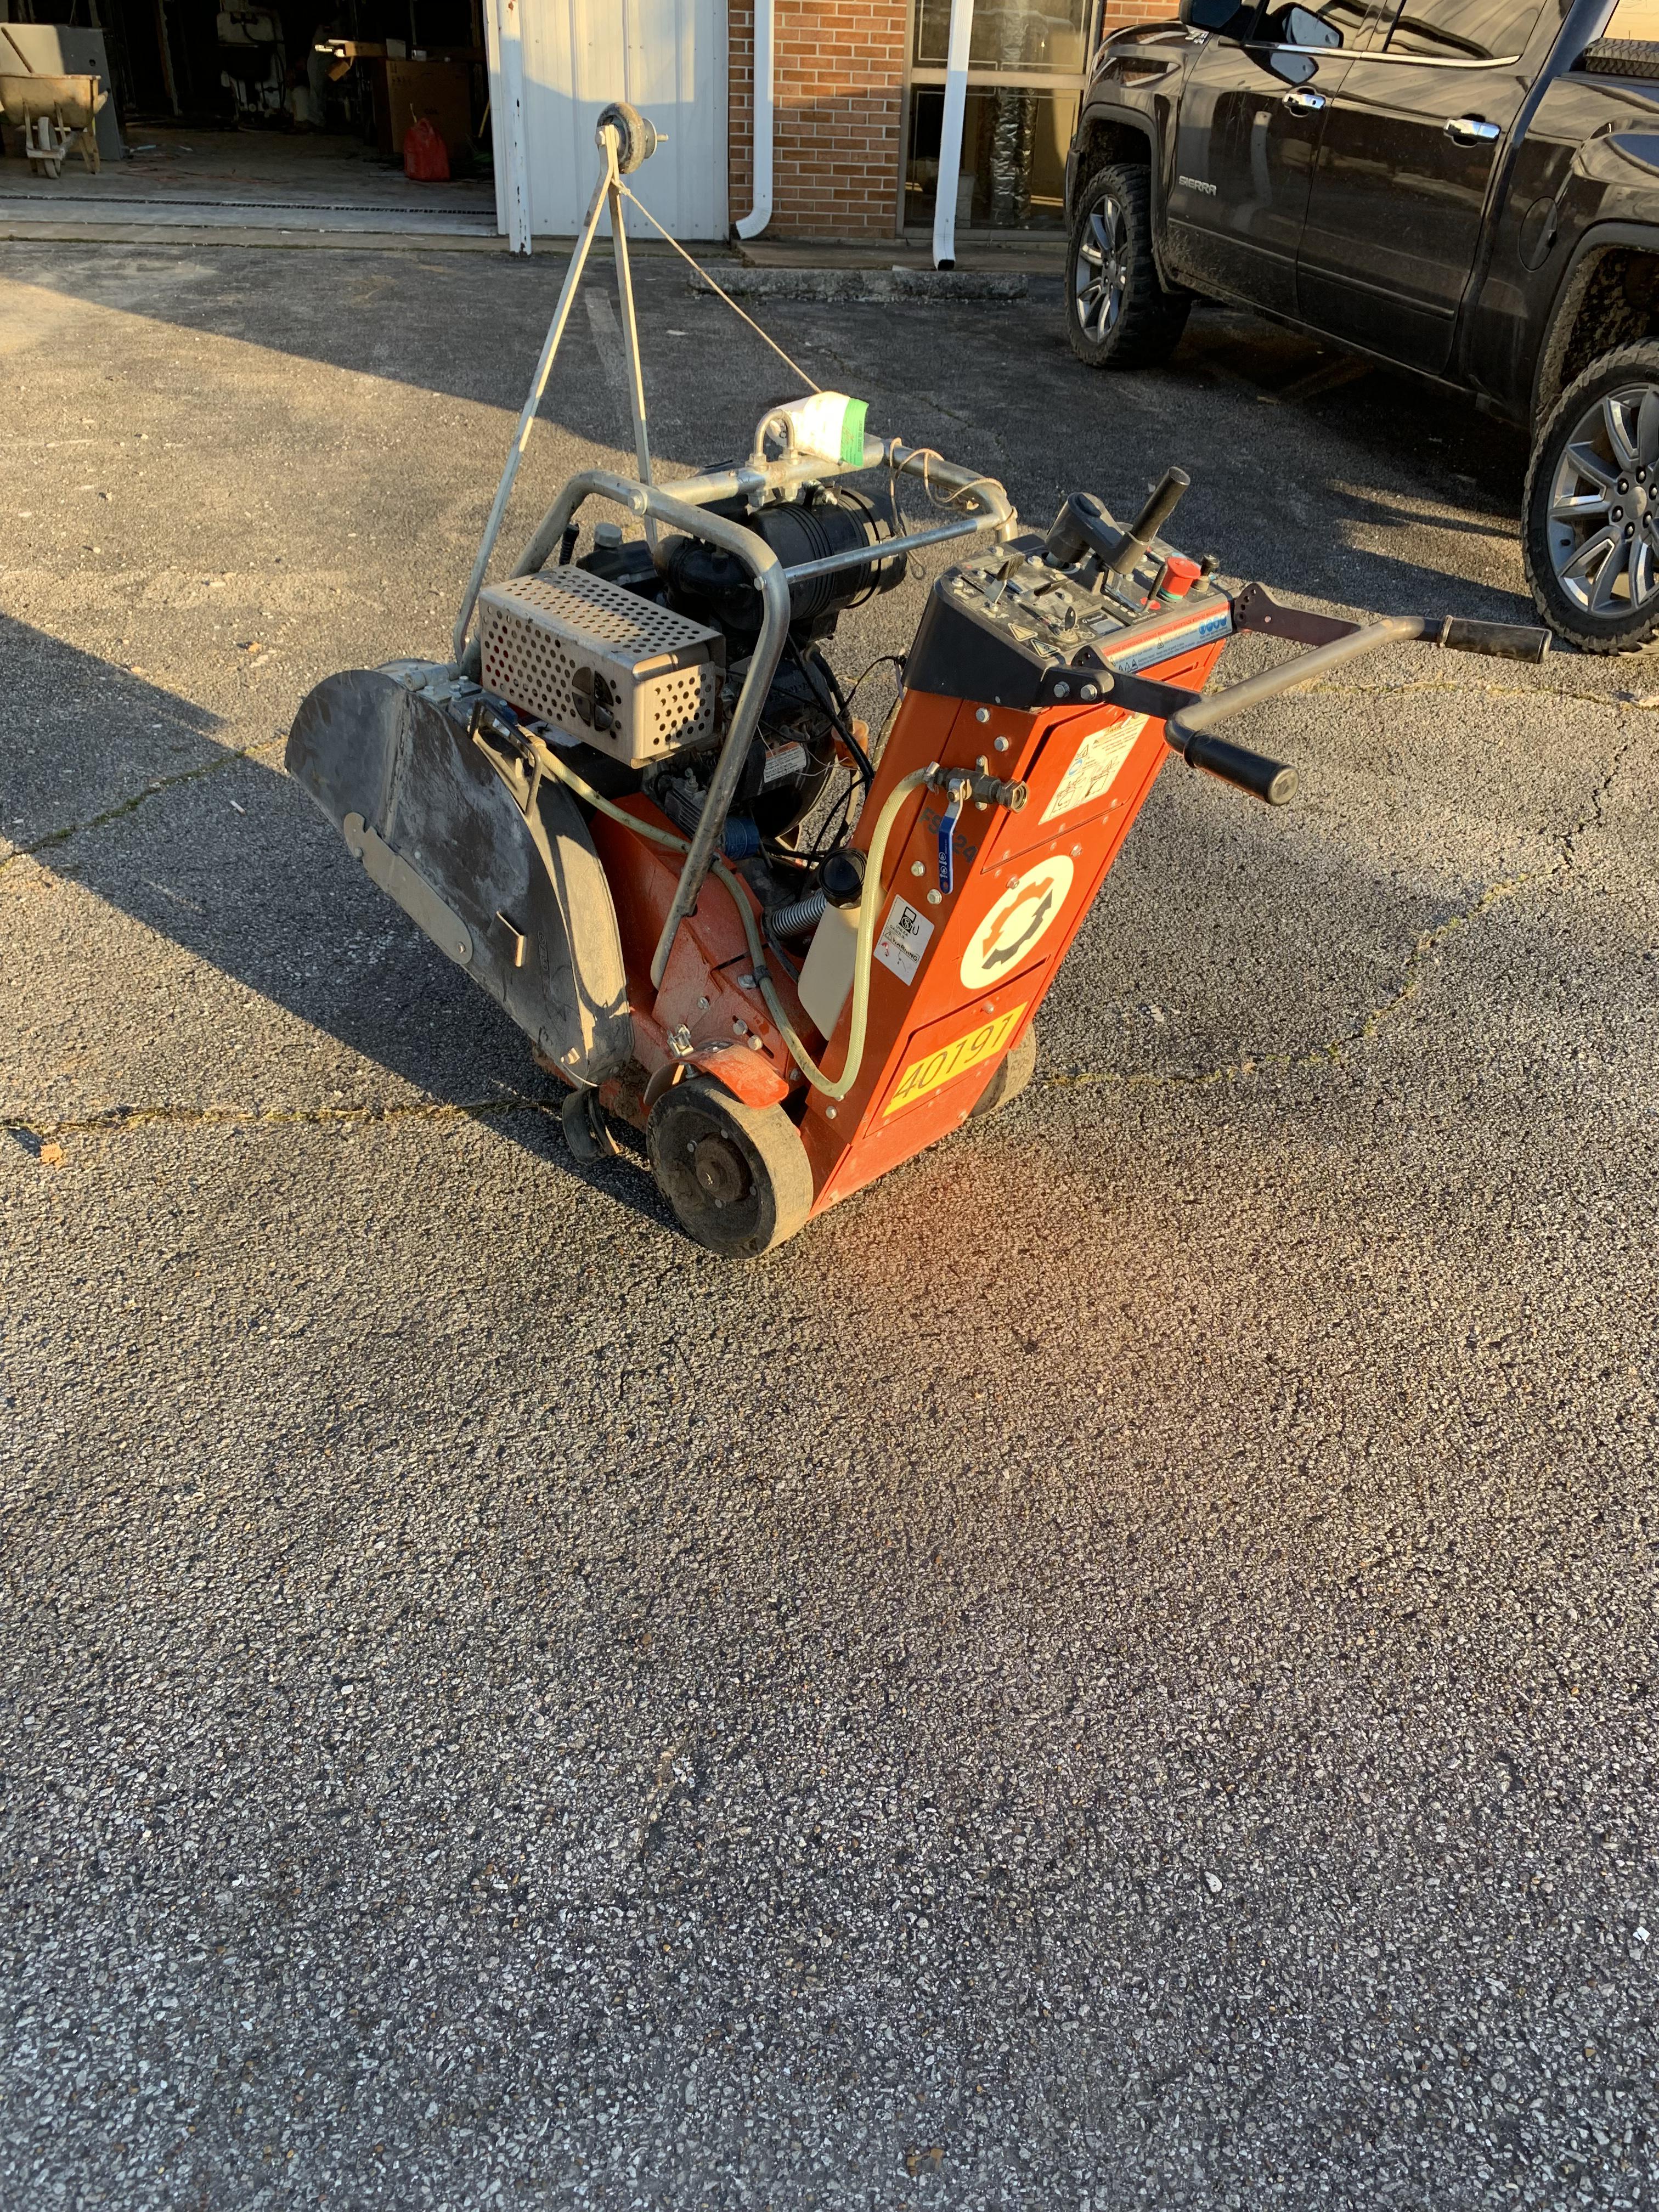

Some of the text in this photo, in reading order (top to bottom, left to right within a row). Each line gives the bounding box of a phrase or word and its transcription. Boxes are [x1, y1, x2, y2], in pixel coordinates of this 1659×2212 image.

[1178, 176, 1217, 196] SIERRA
[893, 937, 918, 962] WARNING
[893, 1013, 1013, 1099] 40191
